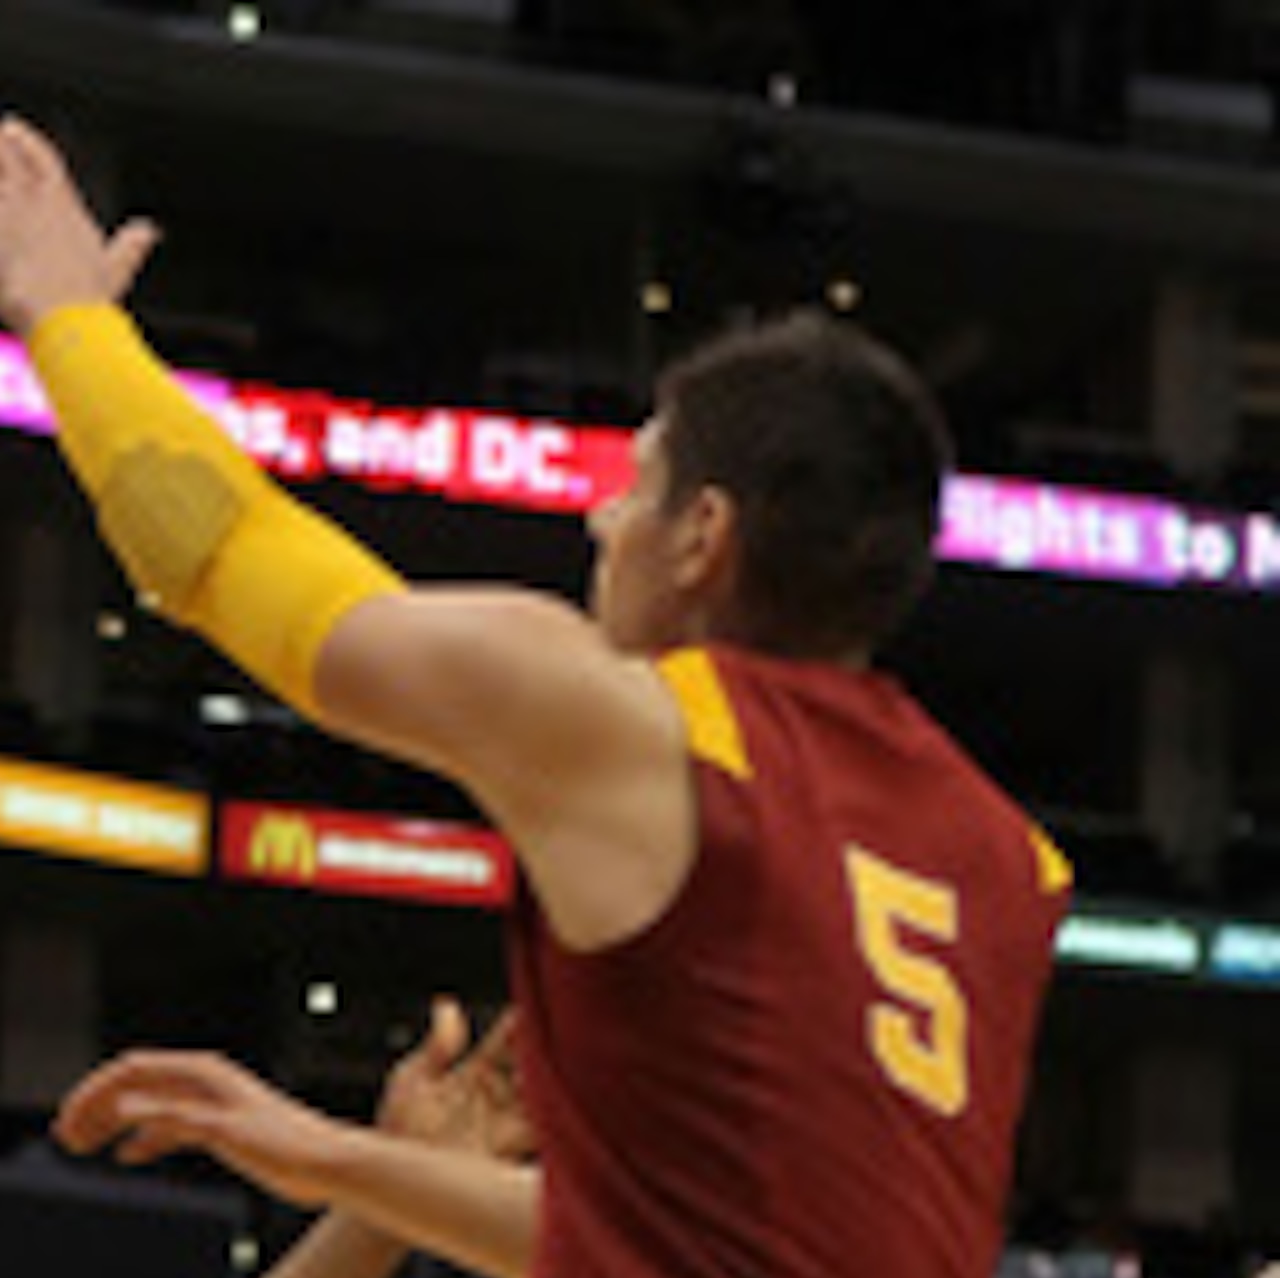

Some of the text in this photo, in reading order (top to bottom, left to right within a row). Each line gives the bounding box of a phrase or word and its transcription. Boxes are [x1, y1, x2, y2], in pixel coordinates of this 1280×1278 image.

[324, 408, 452, 478] and
[940, 474, 1140, 572] lights
[1158, 500, 1236, 580] to
[840, 842, 968, 1118] 5
